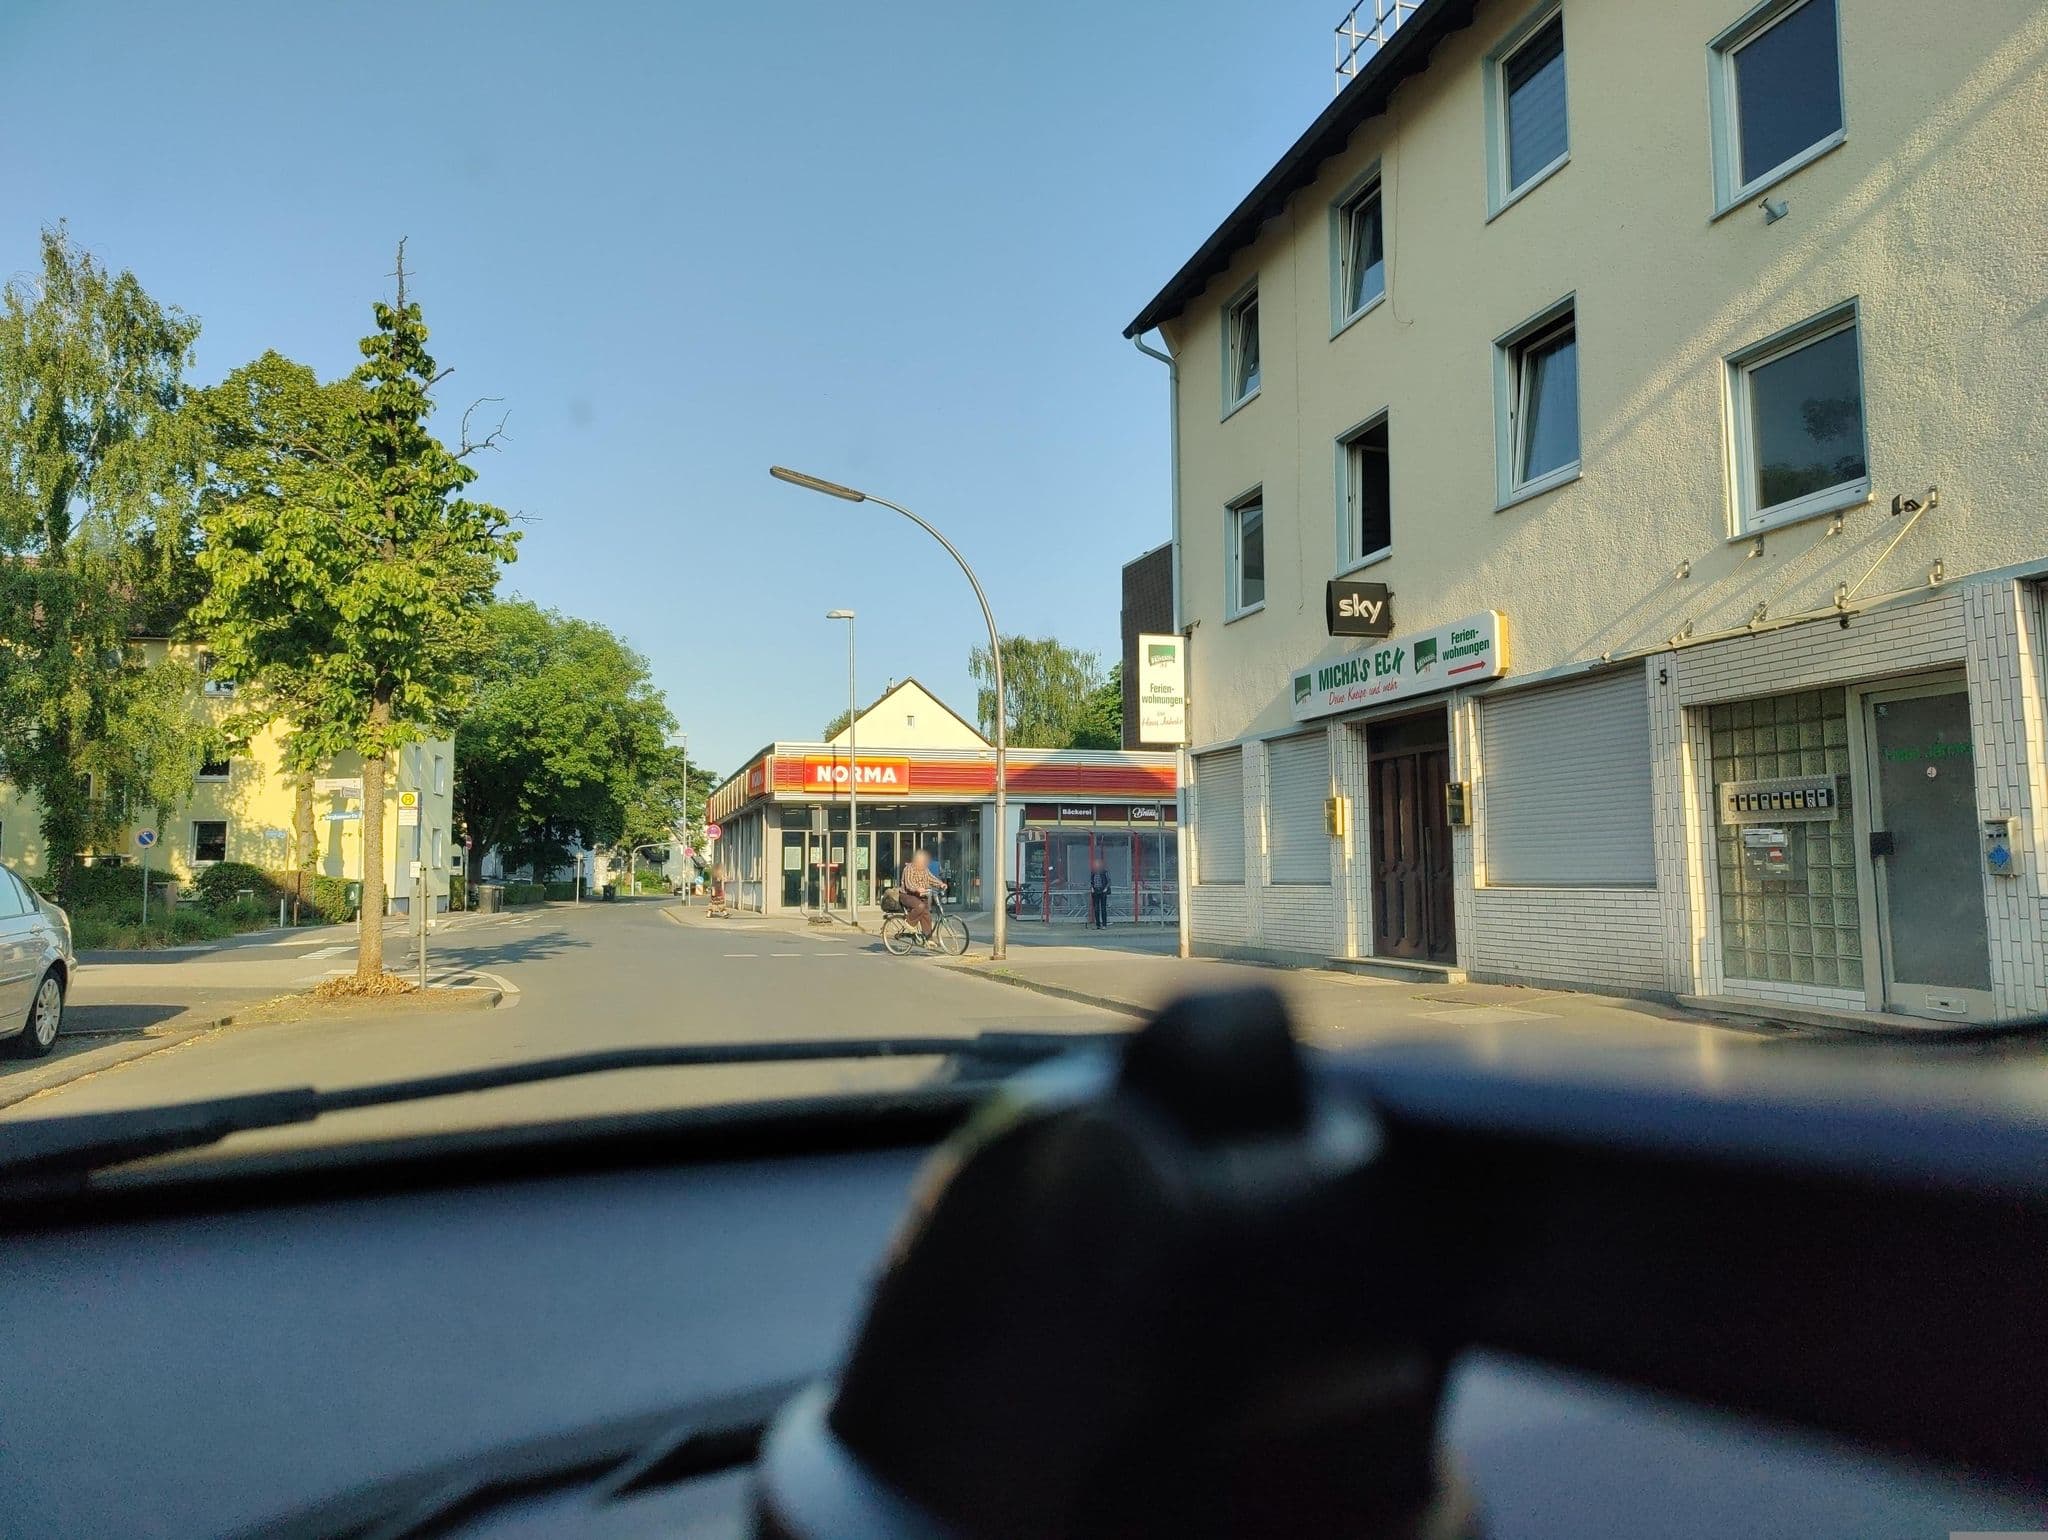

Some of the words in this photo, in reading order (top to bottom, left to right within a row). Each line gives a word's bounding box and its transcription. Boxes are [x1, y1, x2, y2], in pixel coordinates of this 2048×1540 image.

[1339, 593, 1383, 624] sky
[1451, 628, 1480, 645] Ferien-
[1442, 639, 1490, 661] wohnungen
[1318, 657, 1371, 692] MICHA'S
[1375, 647, 1405, 676] ECK
[1150, 682, 1175, 694] Ferien-
[1141, 694, 1184, 707] wohnungen
[816, 765, 897, 783] NORMA
